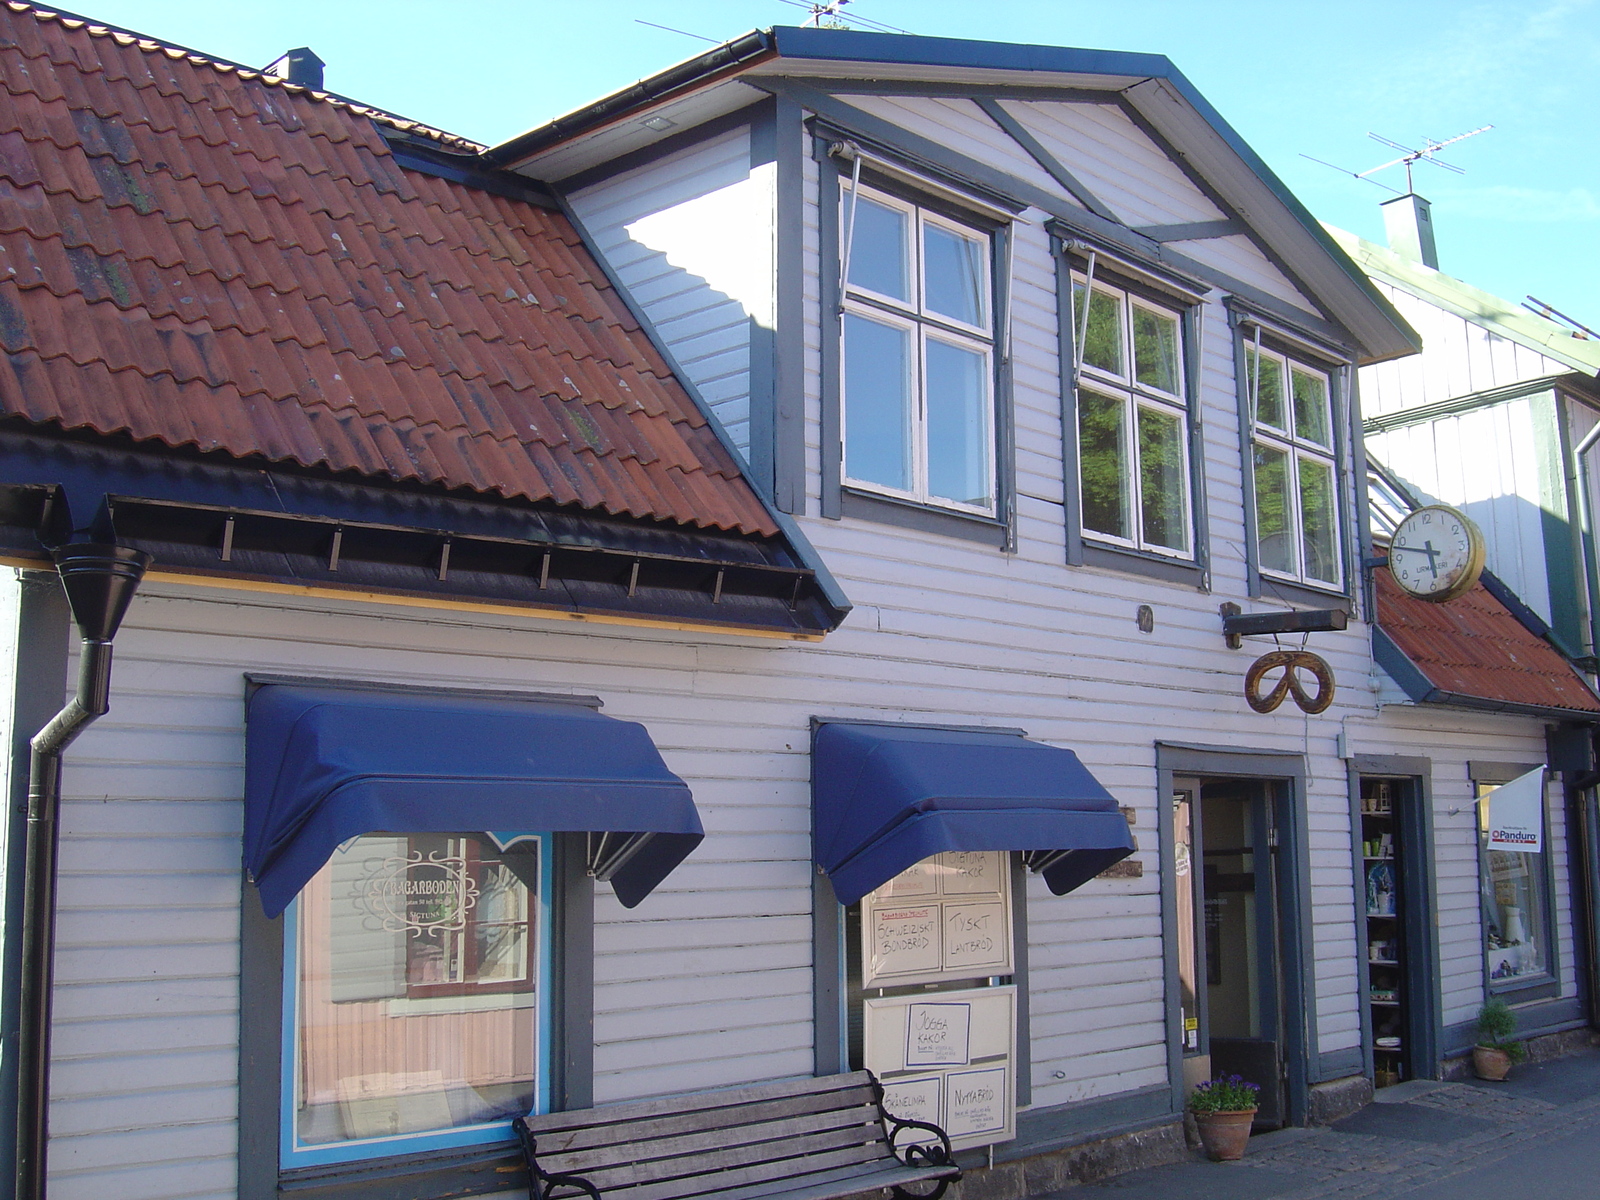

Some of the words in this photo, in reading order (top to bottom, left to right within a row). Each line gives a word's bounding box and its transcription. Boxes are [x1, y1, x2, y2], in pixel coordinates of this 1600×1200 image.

[1422, 514, 1431, 525] 12
[1408, 522, 1416, 532] 11
[1451, 524, 1459, 535] 2
[1397, 536, 1406, 547] 10
[1458, 540, 1465, 551] 3
[1396, 554, 1403, 564] 9
[1416, 562, 1448, 573] URMERI
[1402, 569, 1409, 580] 8
[1413, 579, 1420, 590] 7
[1430, 581, 1437, 591] 6
[1500, 830, 1535, 840] Panduro
[390, 880, 459, 895] BAGARBODEN
[410, 911, 440, 919] SIGTUNA
[950, 912, 990, 932] TYSKT
[918, 1031, 947, 1044] KAKOR
